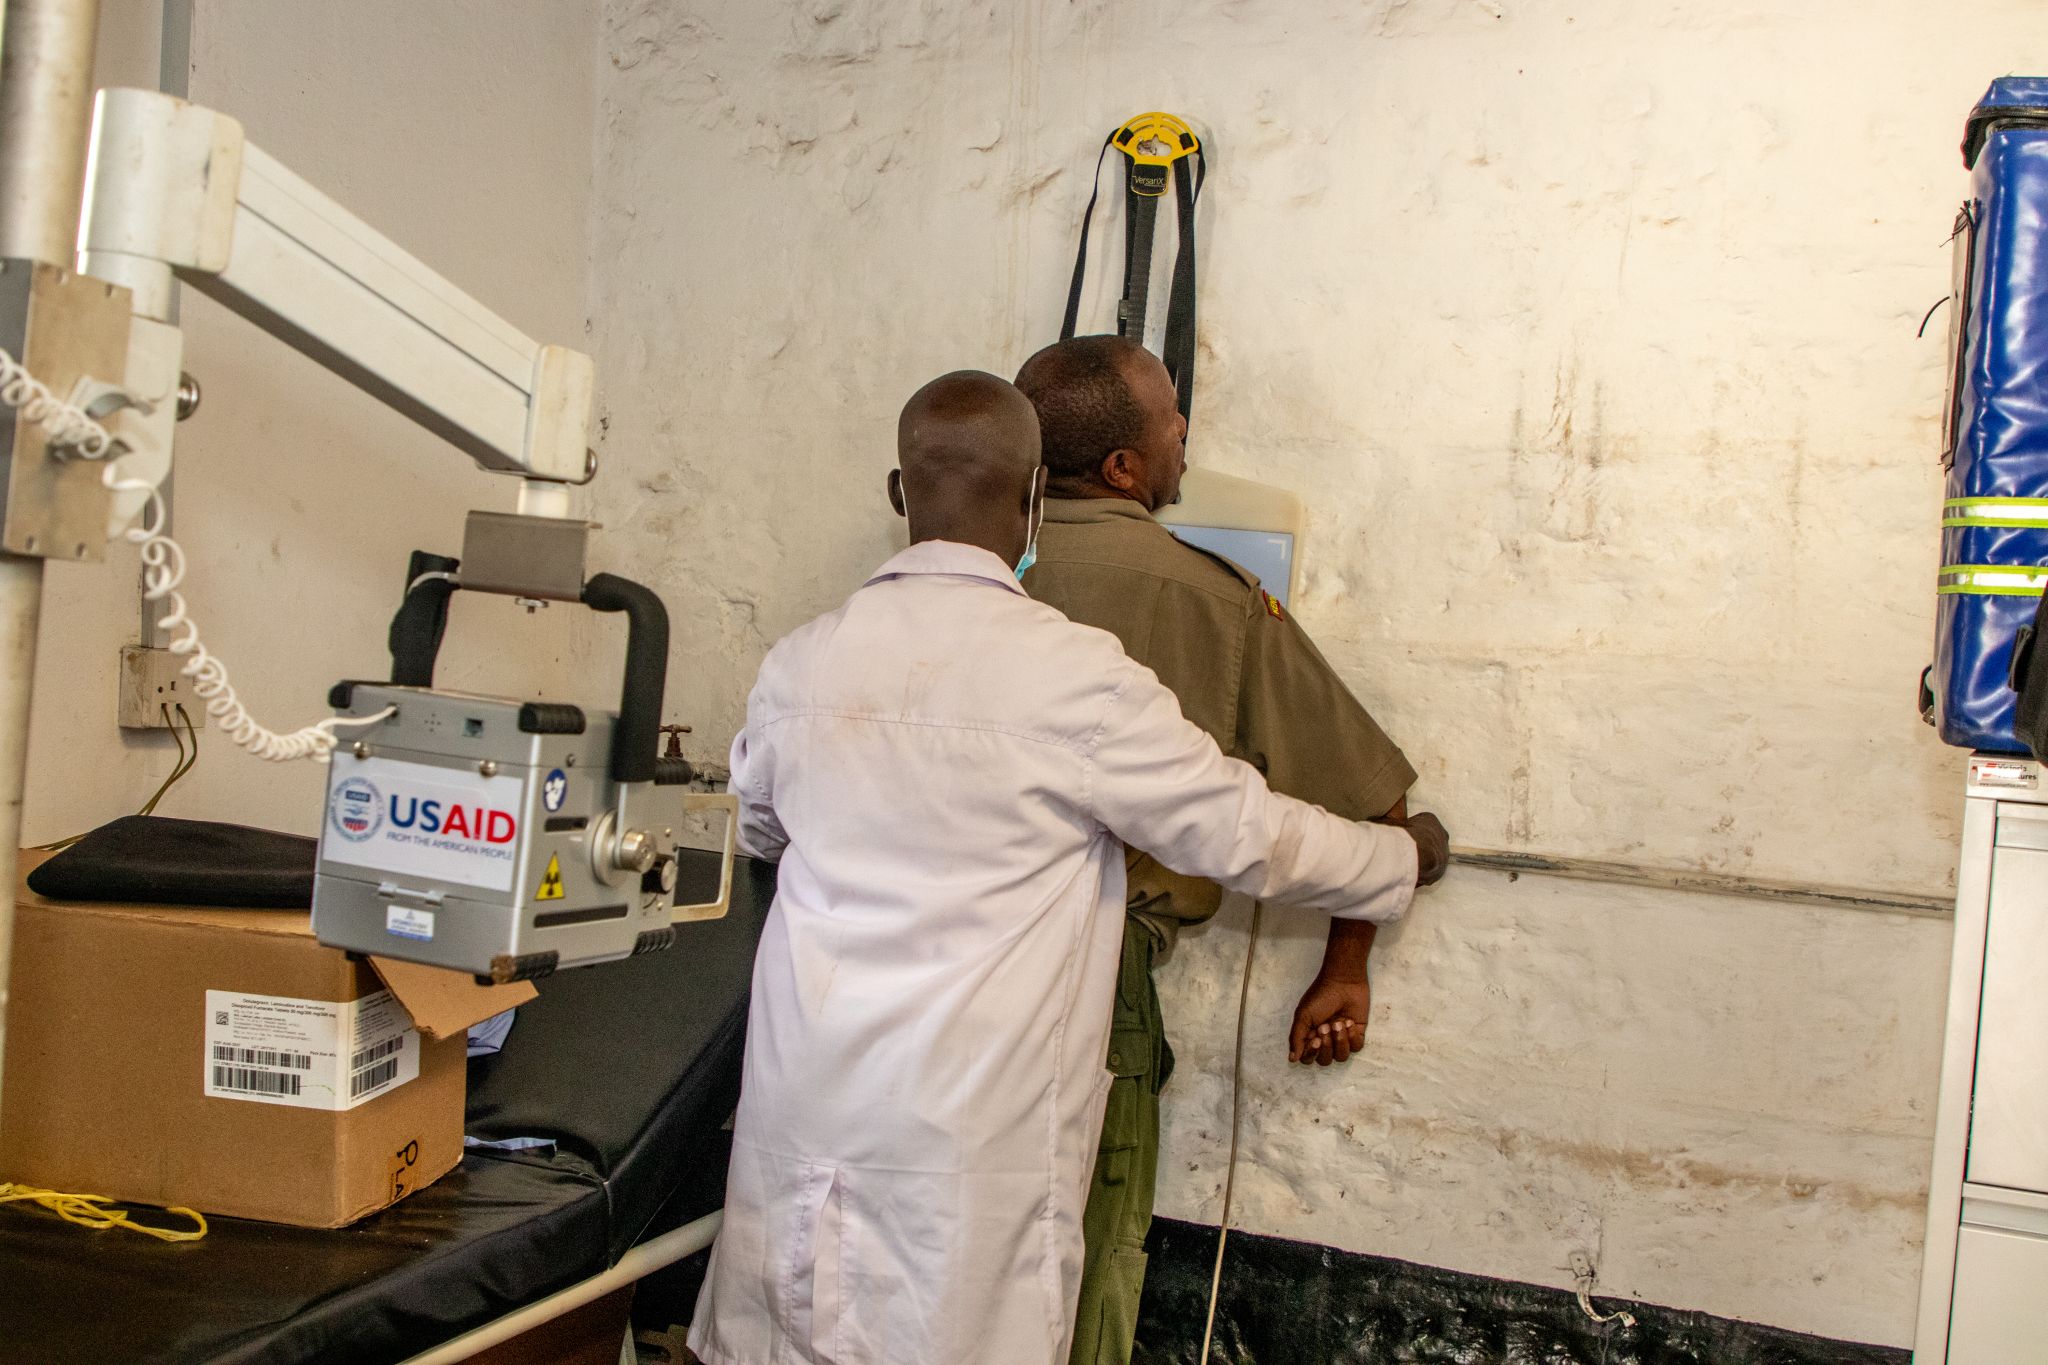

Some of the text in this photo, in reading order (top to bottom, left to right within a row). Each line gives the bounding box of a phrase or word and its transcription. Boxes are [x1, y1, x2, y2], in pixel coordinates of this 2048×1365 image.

[390, 794, 516, 844] USAID
[387, 831, 513, 861] FROM THE AMERICAN PEOPLE
